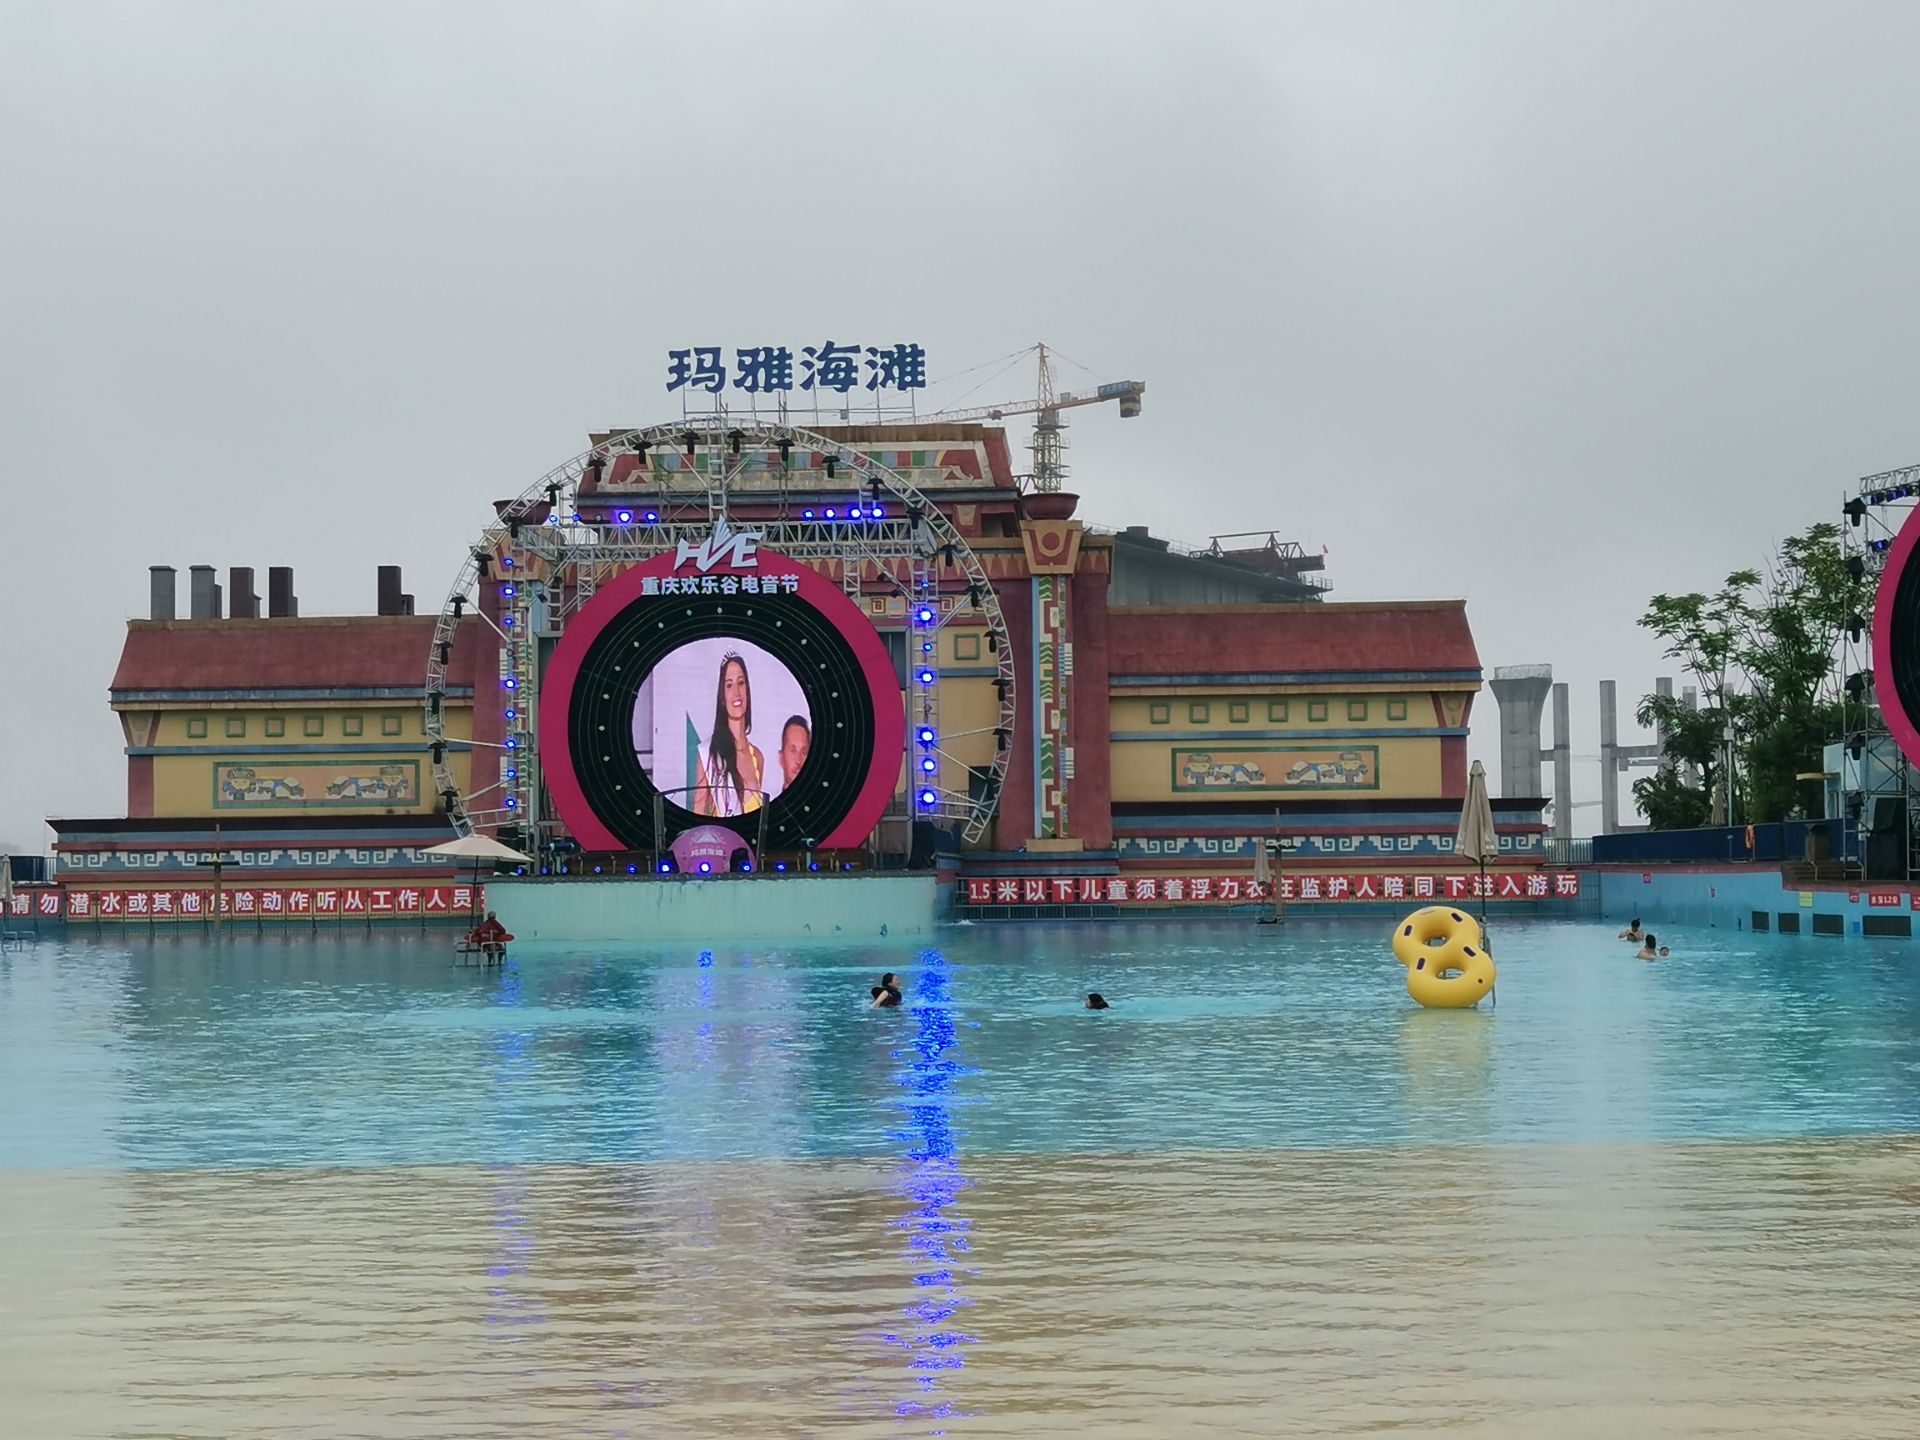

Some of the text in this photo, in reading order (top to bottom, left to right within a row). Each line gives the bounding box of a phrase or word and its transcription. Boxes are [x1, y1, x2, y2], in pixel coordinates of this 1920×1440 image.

[666, 340, 926, 393] 玛雅海滩
[640, 574, 799, 596] 重庆欢乐谷电音节
[0, 888, 485, 914] 请勿潜水或其他危险动作听从工作人员
